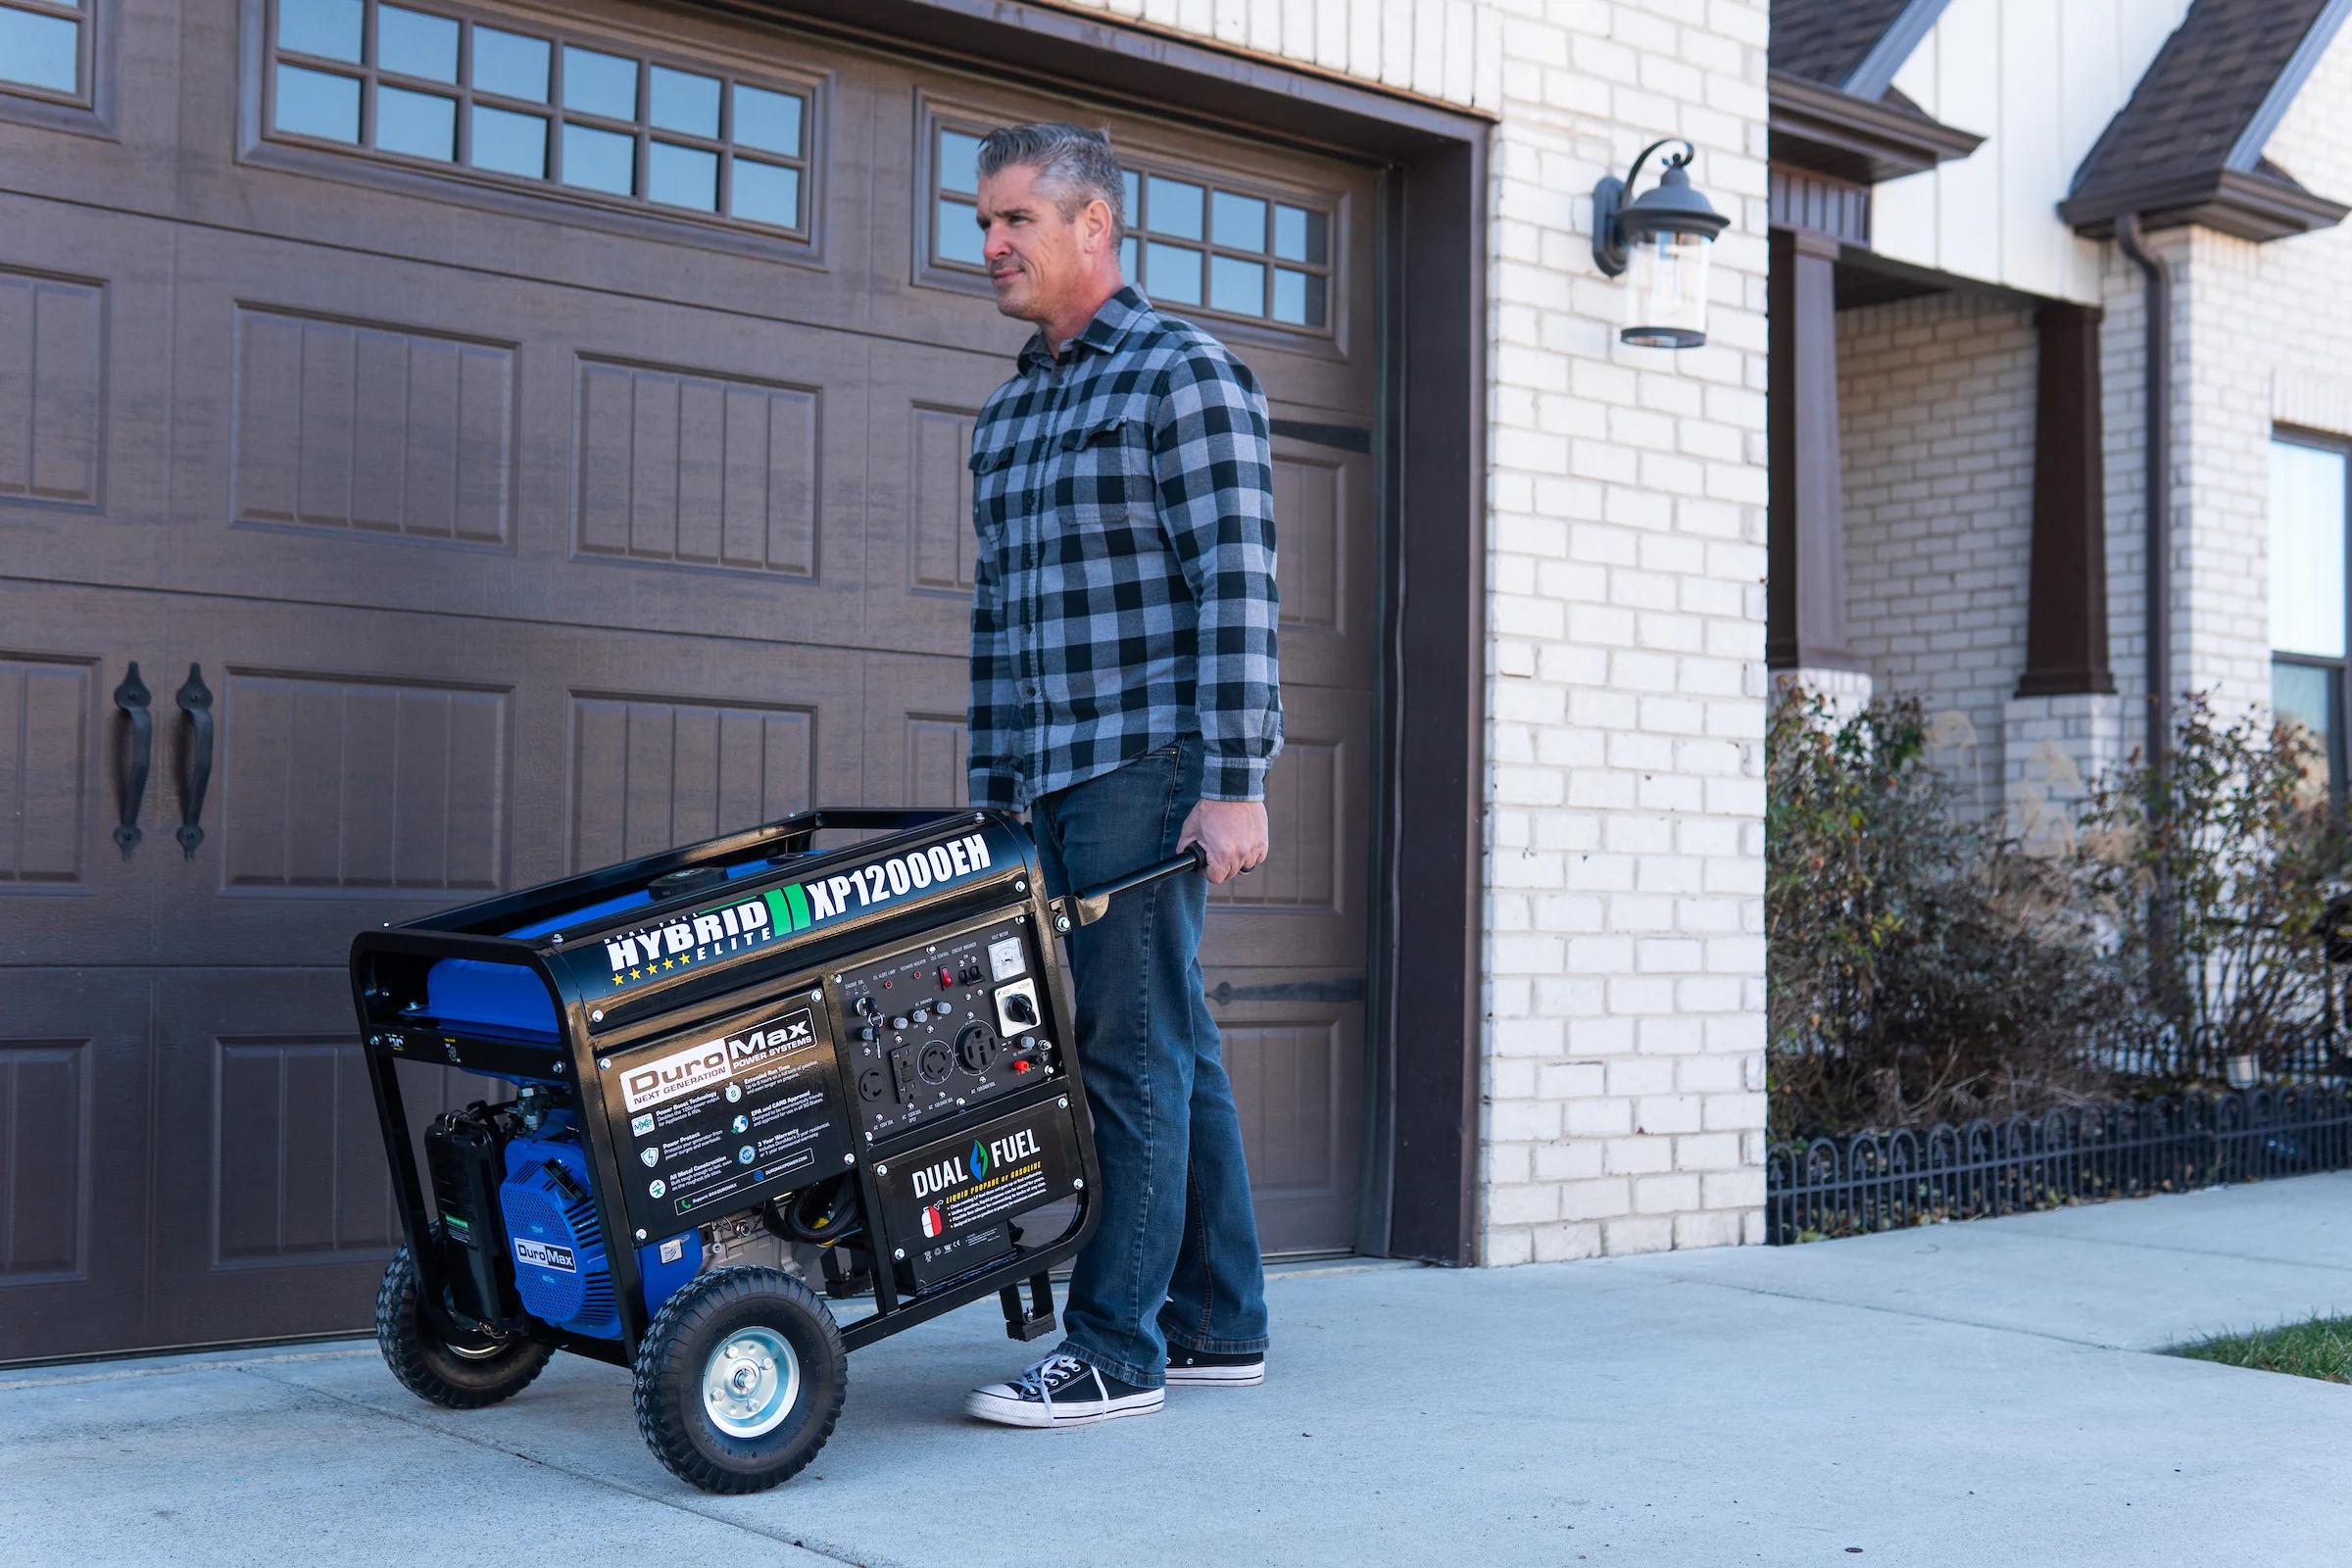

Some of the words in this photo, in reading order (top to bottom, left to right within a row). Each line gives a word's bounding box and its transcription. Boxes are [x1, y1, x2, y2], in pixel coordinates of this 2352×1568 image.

[806, 834, 991, 920] XP12000EH
[607, 901, 768, 971] HYBRID
[696, 927, 770, 960] ELITE
[733, 1052, 767, 1070] POWER
[769, 1035, 812, 1056] SYSTEMS
[633, 1091, 661, 1105] NEXT
[663, 1066, 726, 1095] GENERATION
[744, 1071, 767, 1084] Extended
[767, 1067, 778, 1076] Run
[778, 1063, 790, 1072] Time
[656, 1106, 673, 1116] Power
[673, 1101, 689, 1110] Boost
[689, 1092, 717, 1105] Technology
[751, 1107, 762, 1116] EPA
[762, 1103, 772, 1112] and
[772, 1098, 787, 1108] CARB
[787, 1089, 810, 1103] Approved
[662, 1139, 680, 1149] Power
[680, 1131, 701, 1143] Protect
[762, 1136, 775, 1145] Year
[774, 1128, 800, 1141] Warranty
[677, 1167, 694, 1178] Metal
[694, 1155, 727, 1172] Construction
[911, 1155, 968, 1200] DUAL
[990, 1128, 1041, 1168] FUEL
[946, 1189, 969, 1203] LIQUID
[970, 1177, 1001, 1195] PROPANE
[1010, 1160, 1042, 1179] GASOLINE
[517, 1244, 574, 1266] DuroMax
